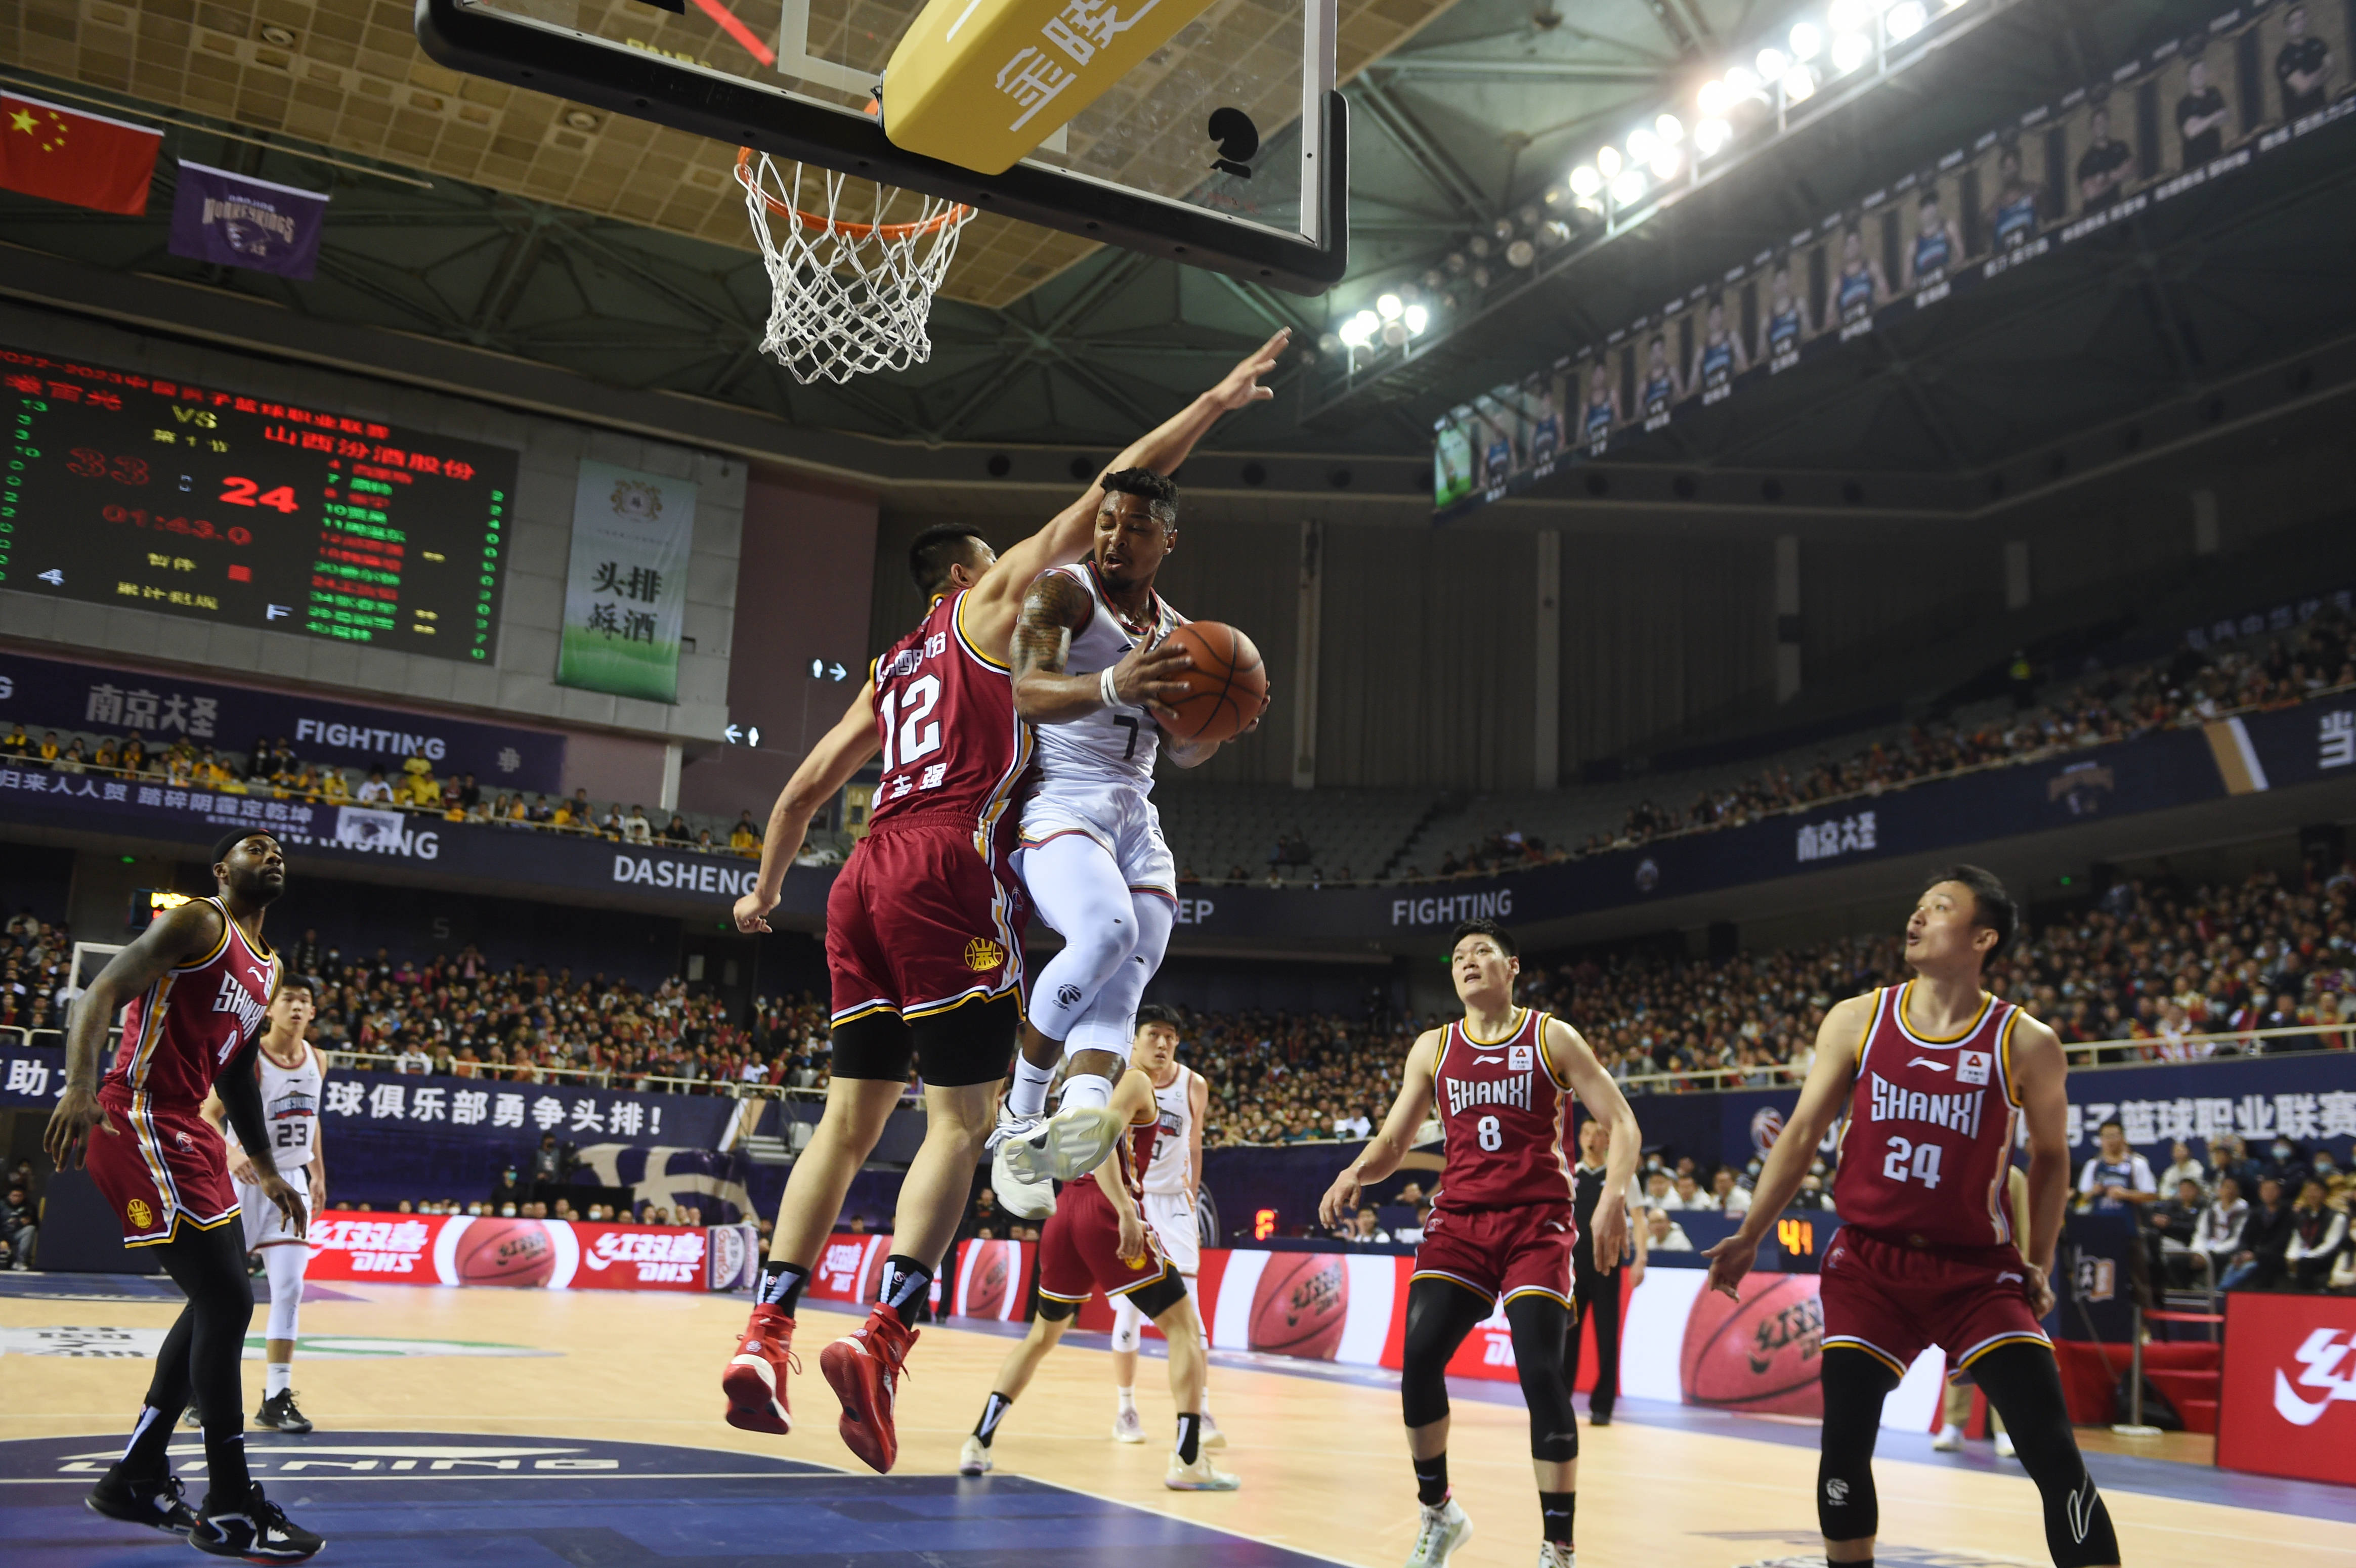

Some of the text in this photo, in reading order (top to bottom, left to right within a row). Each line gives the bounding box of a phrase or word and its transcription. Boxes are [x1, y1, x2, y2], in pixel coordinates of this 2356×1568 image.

[173, 405, 218, 428] VS
[264, 425, 476, 481] 山西汾酒股份
[66, 447, 300, 514] 33 24
[37, 568, 65, 586] 4
[591, 561, 662, 603] 头排
[85, 683, 218, 737] 南京大圣
[879, 673, 941, 774] 12
[296, 718, 446, 760] FIGHTING
[1114, 713, 1139, 760] 7
[2318, 710, 2354, 769] 当
[0, 769, 314, 823] 归来人人贺 踏碎阴霾定乾坤
[1796, 811, 1876, 862] 南京大圣
[613, 854, 760, 897] DASHENG
[1178, 898, 1214, 925] EP
[1393, 889, 1513, 925] FIGHTING
[211, 970, 268, 1041] SHANXI
[218, 1030, 237, 1065] 4
[5, 1059, 49, 1097] 助
[1445, 1071, 1534, 1117] SHANXI
[1870, 1070, 1986, 1140] SHANXI
[277, 1123, 307, 1147] 23
[1478, 1115, 1503, 1152] 8
[1882, 1136, 1942, 1190] 24
[306, 1219, 429, 1254] 红双喜
[587, 1231, 706, 1269] 红双喜
[350, 1250, 423, 1274] DHS
[636, 1262, 702, 1283] DHS
